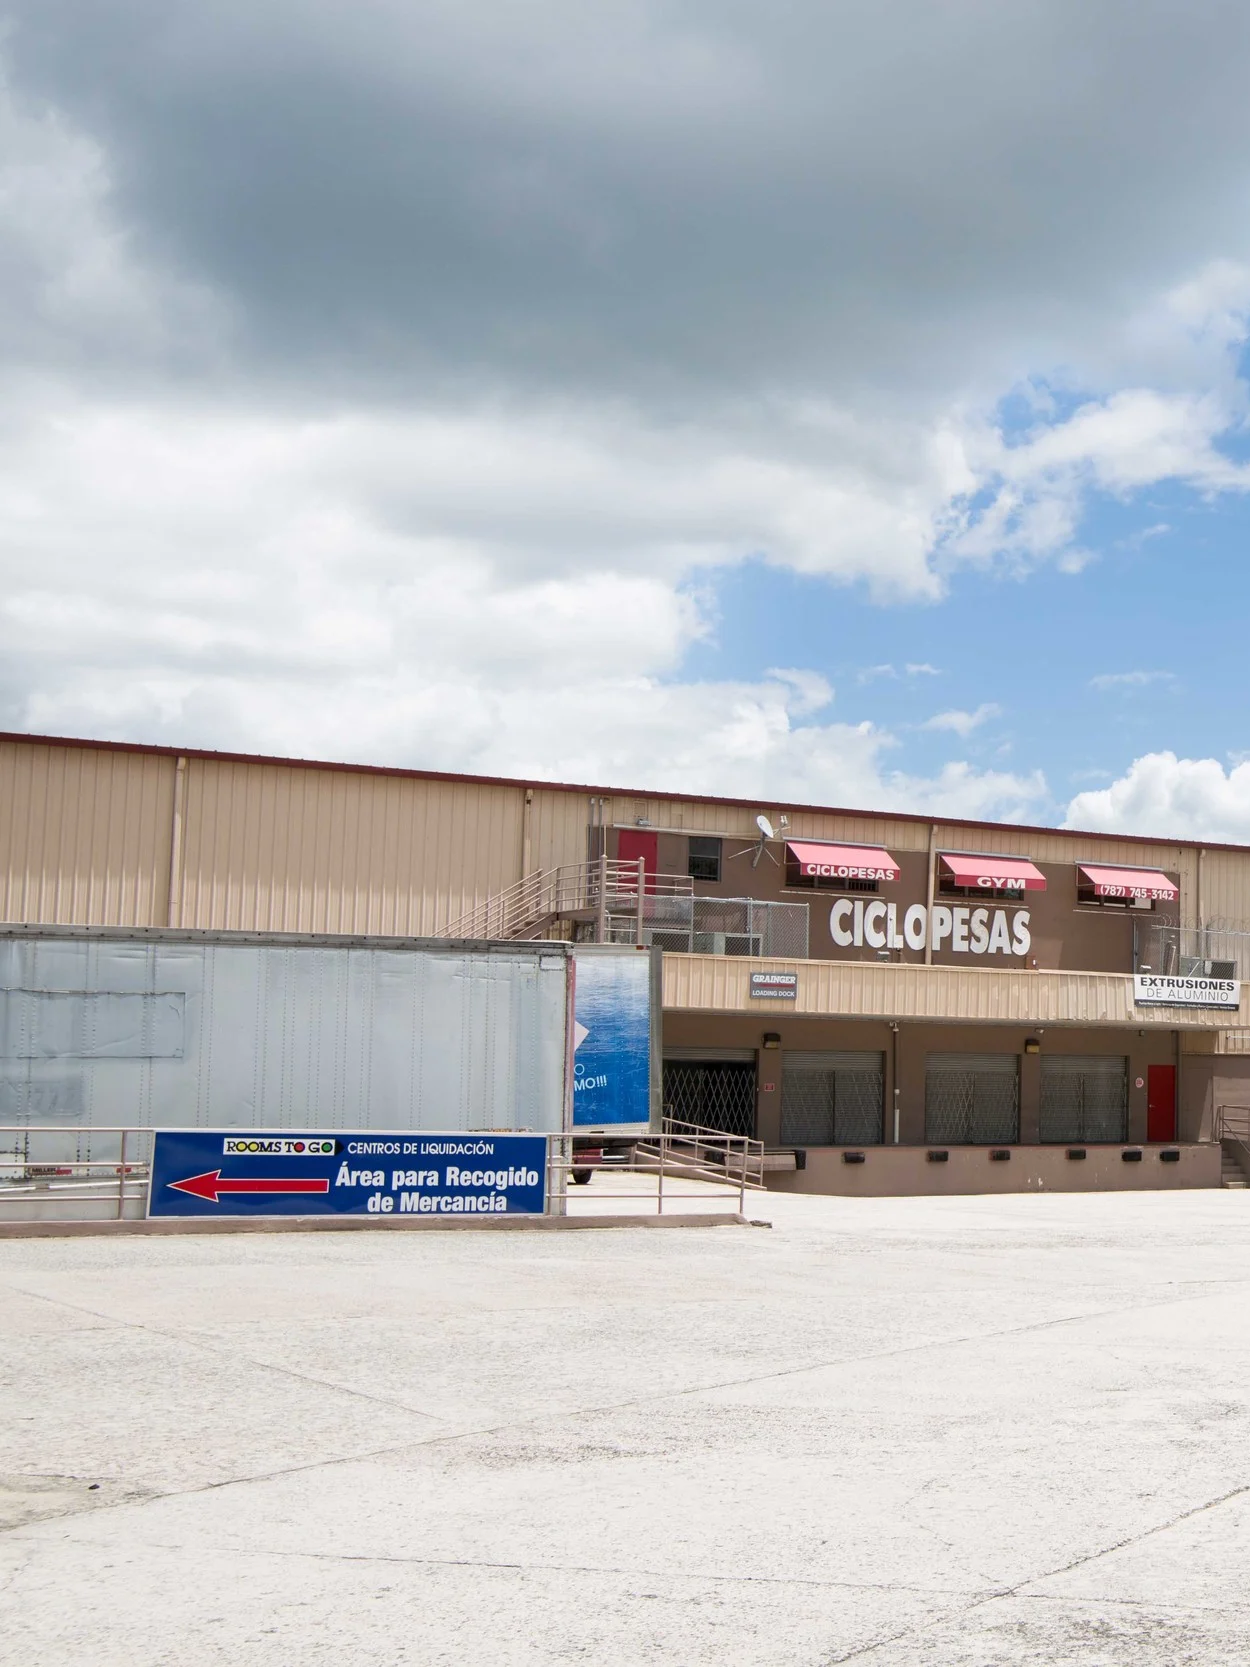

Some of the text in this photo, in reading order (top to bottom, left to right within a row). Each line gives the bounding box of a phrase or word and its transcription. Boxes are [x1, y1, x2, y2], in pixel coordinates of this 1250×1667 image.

[806, 863, 895, 881] CICLOPESAS
[977, 876, 1026, 889] GYM
[1100, 885, 1174, 900] (787) 745-3142
[829, 898, 1031, 956] CICLOPESAS
[752, 974, 796, 984] GRAINGER
[1140, 976, 1235, 992] EXTRUSIONES
[1146, 987, 1229, 1002] DE ALUMINIO
[226, 1140, 494, 1155] ROOMS TO GO CENTROS DE LIQUIDACIÓN
[335, 1161, 539, 1190] Área para Recogido
[367, 1191, 507, 1213] de Mercancía
